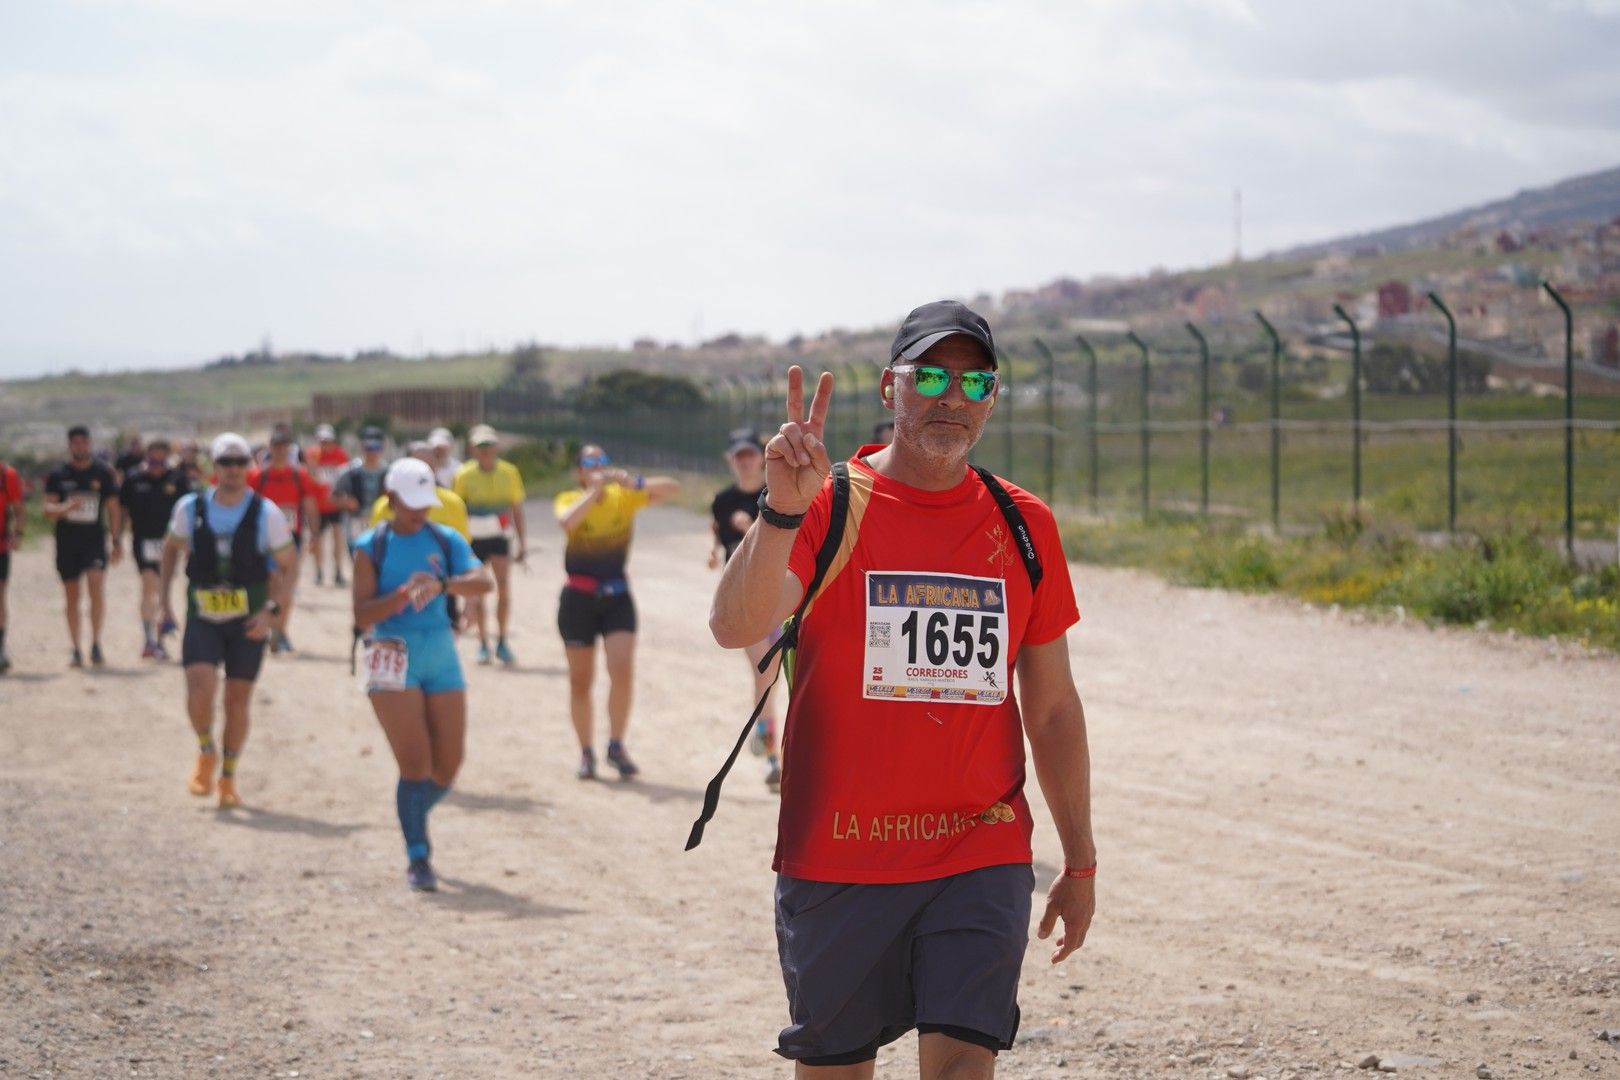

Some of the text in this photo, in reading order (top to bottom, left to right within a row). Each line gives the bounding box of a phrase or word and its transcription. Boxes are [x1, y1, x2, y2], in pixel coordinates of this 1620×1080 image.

[1018, 525, 1035, 560] Quechua
[877, 584, 980, 608] LA AFRICANA
[901, 610, 1000, 669] 1655
[873, 666, 883, 675] 25
[906, 667, 968, 679] CORREDORES
[832, 811, 861, 840] LA
